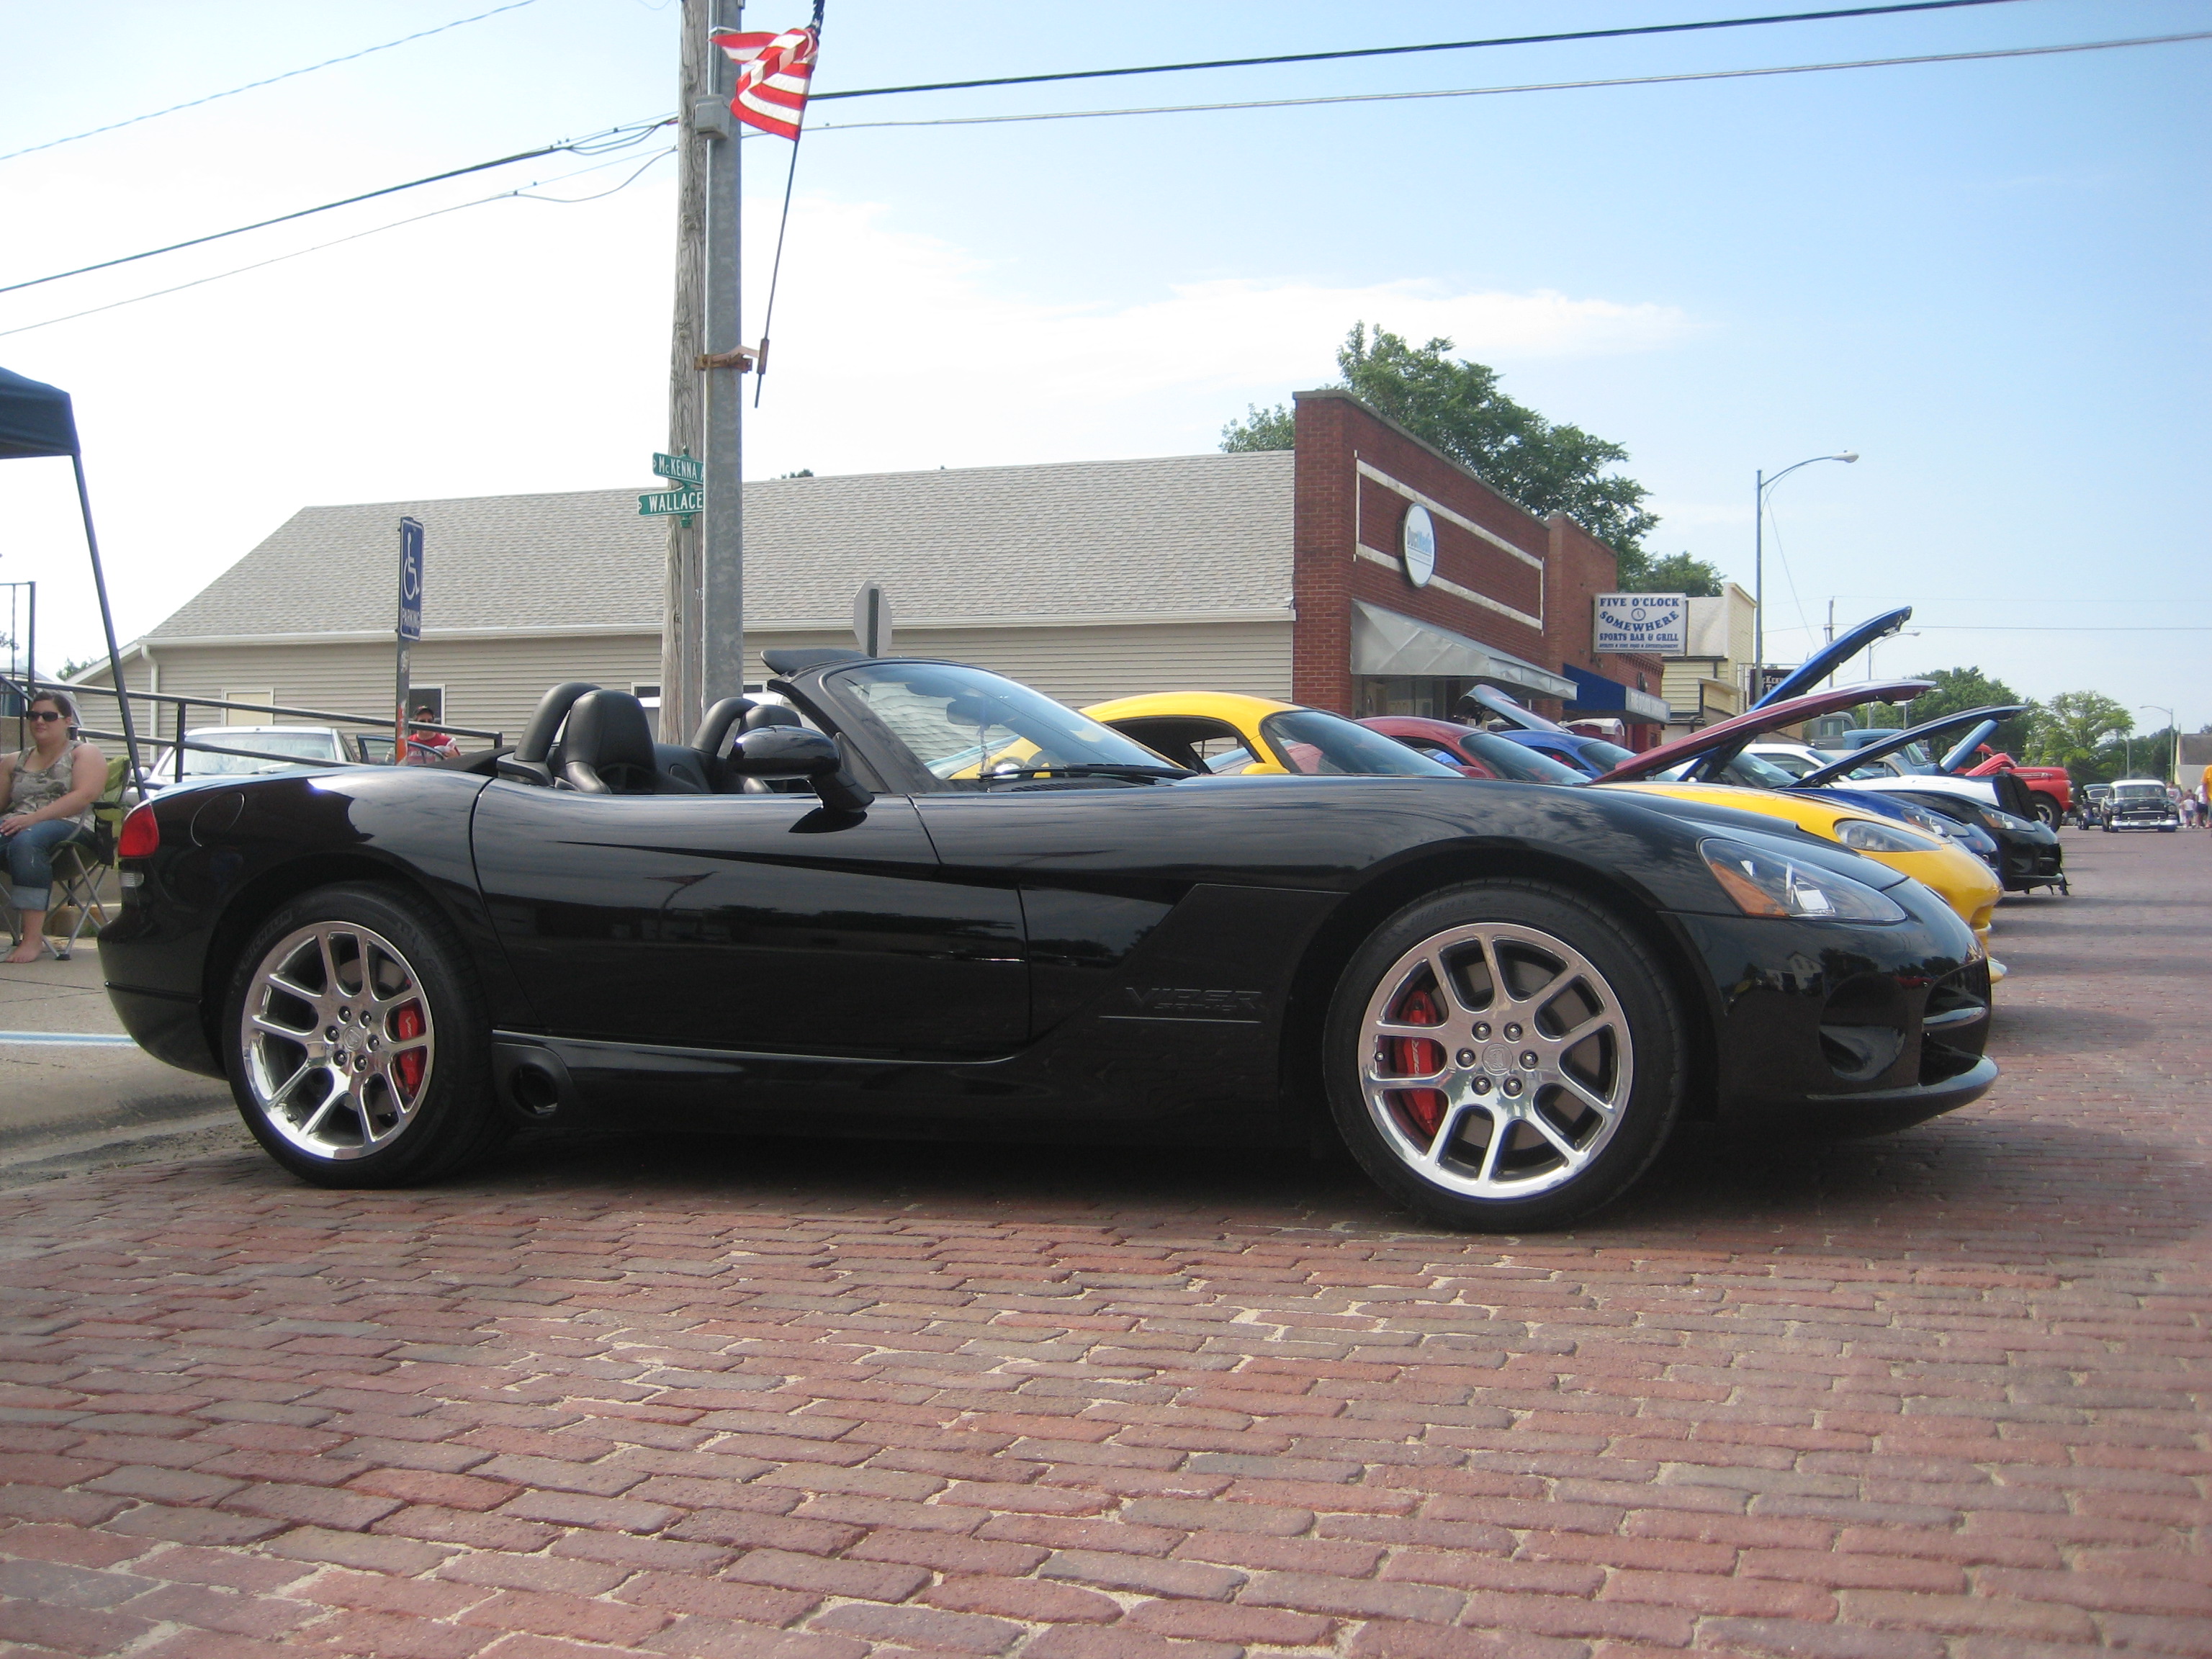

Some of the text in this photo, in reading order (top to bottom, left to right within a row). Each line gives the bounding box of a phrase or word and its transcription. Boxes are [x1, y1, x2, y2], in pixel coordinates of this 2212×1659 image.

[658, 455, 697, 480] McKENNA
[649, 492, 703, 512] WALLACE
[1599, 598, 1679, 607] FIVE O'CLOCK
[1599, 610, 1680, 632] SOMEWHERE
